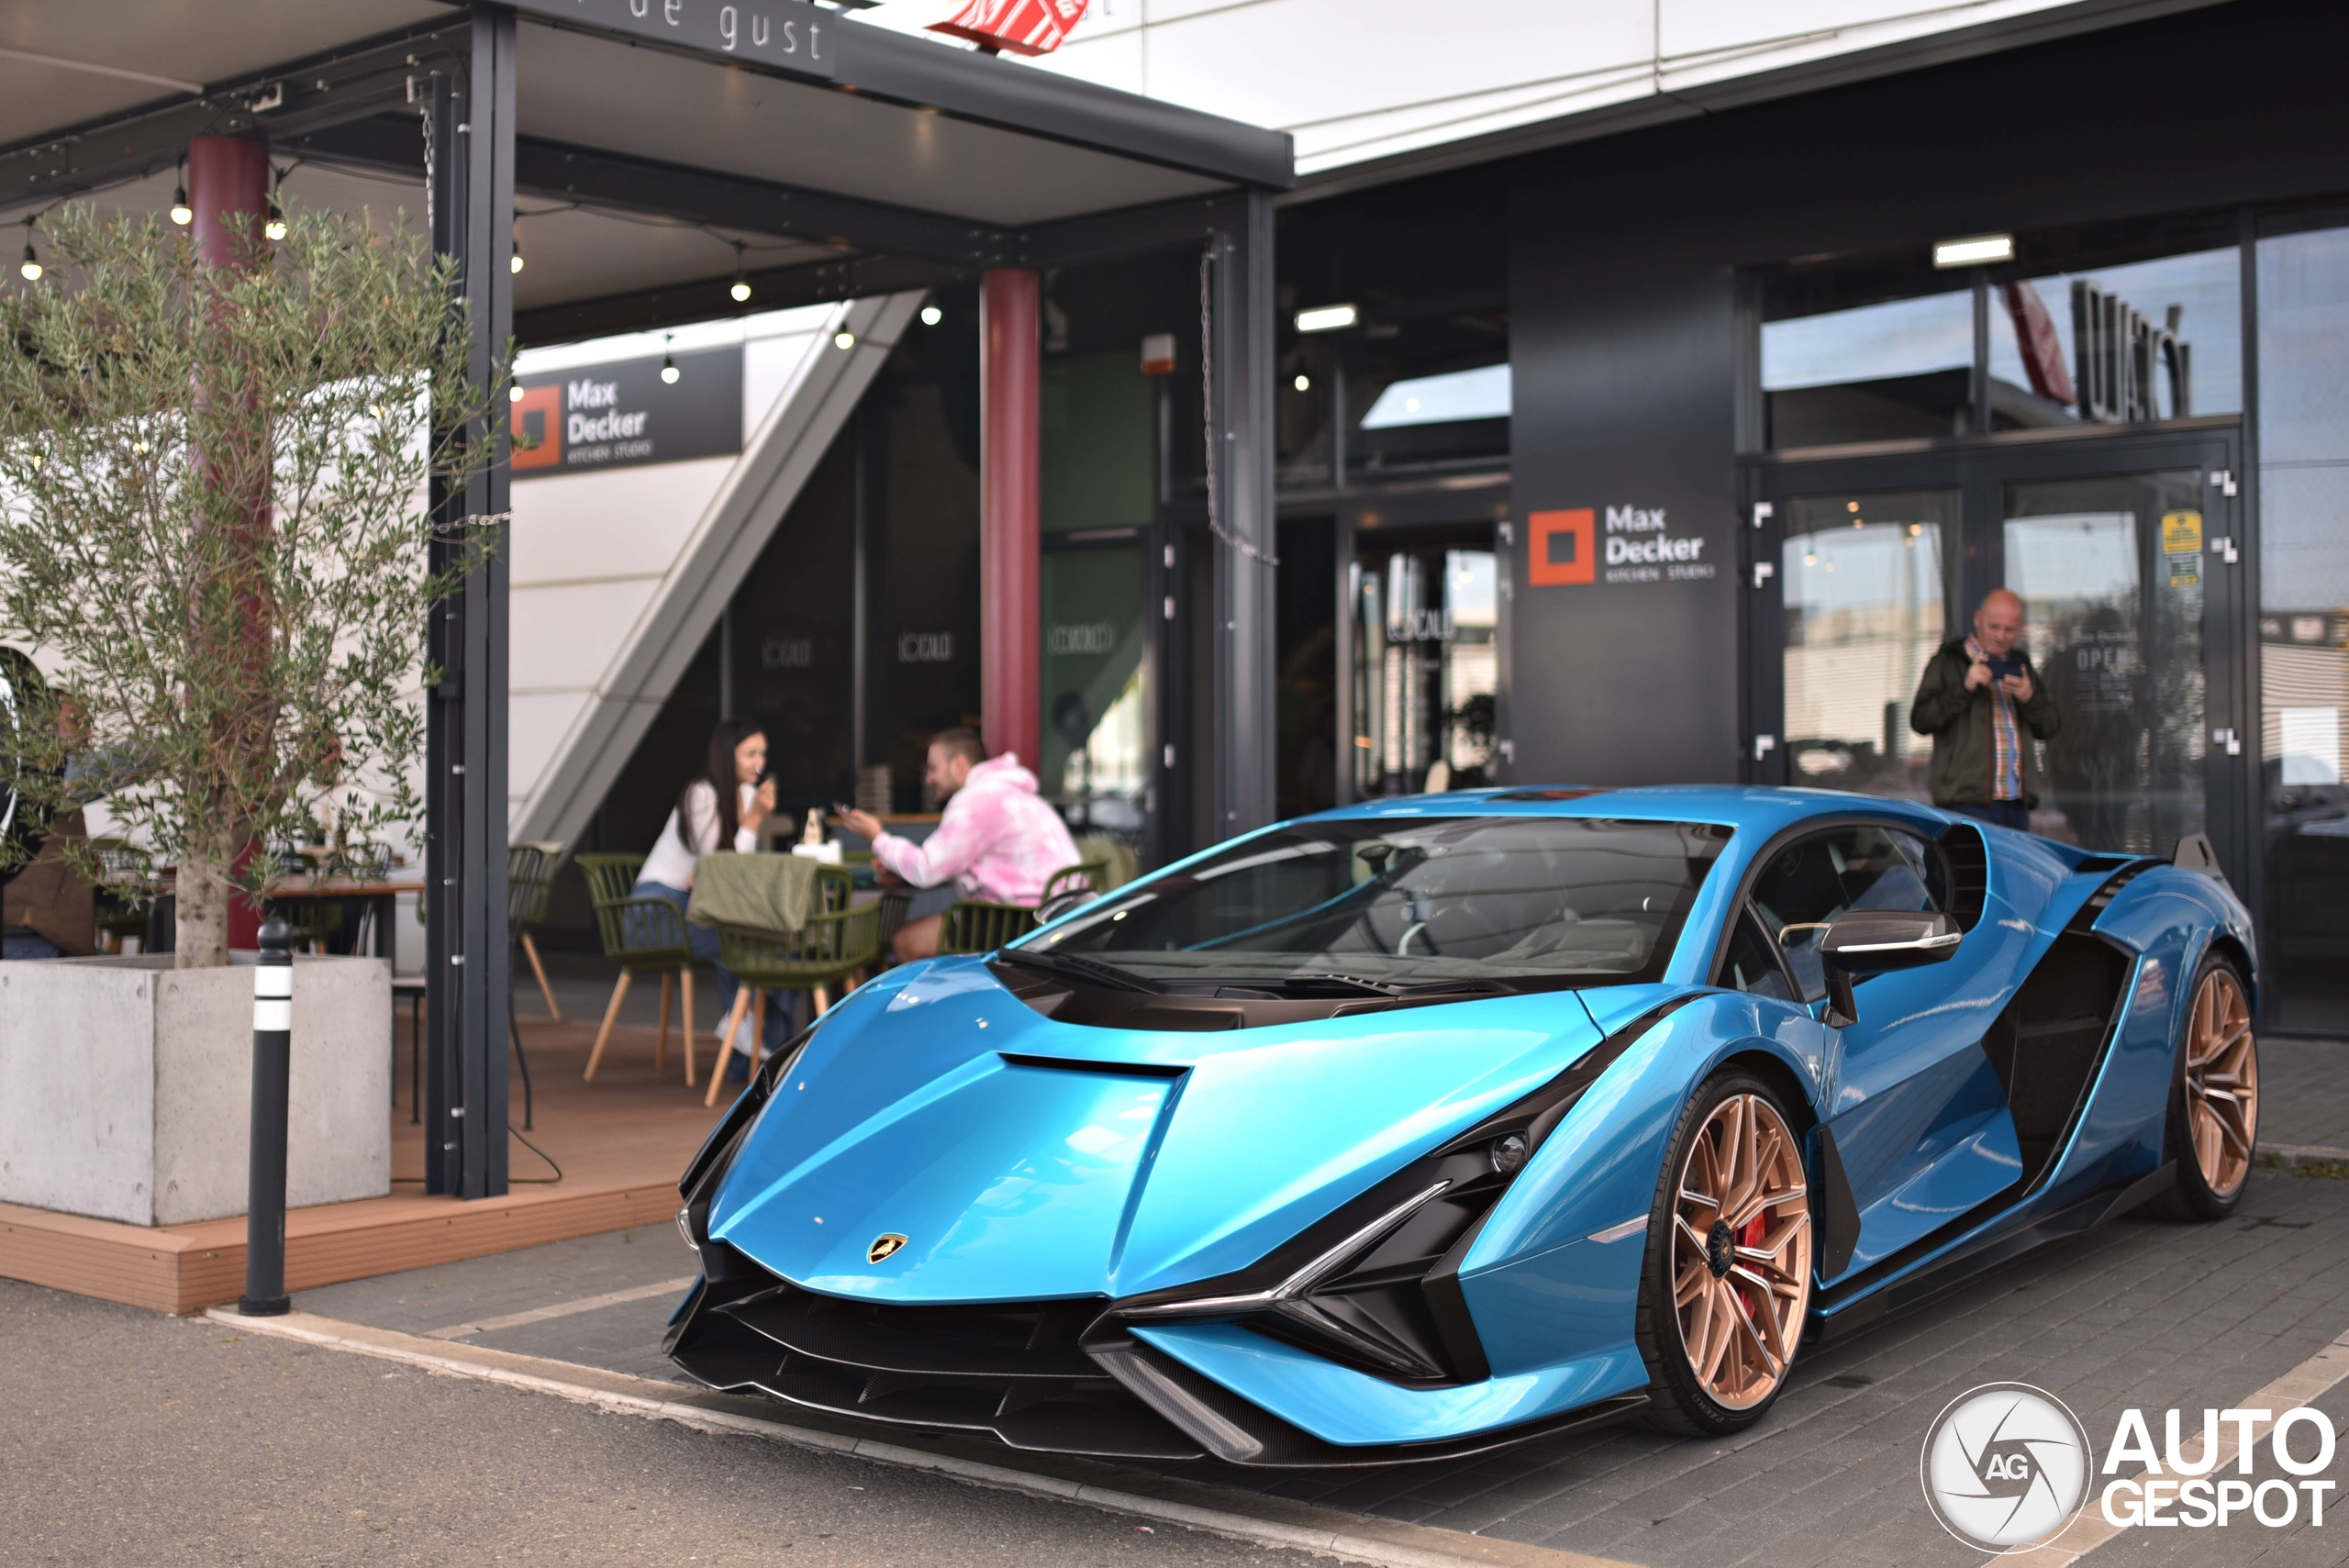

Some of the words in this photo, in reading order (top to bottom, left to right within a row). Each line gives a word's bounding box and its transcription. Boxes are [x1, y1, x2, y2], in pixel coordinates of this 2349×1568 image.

[720, 6, 821, 60] gust
[567, 378, 618, 411] Max
[567, 407, 650, 445] Decker
[567, 445, 610, 464] KITCHEN
[613, 439, 654, 460] STUDIO
[1605, 504, 1666, 533] Max
[1605, 532, 1704, 565] Decker
